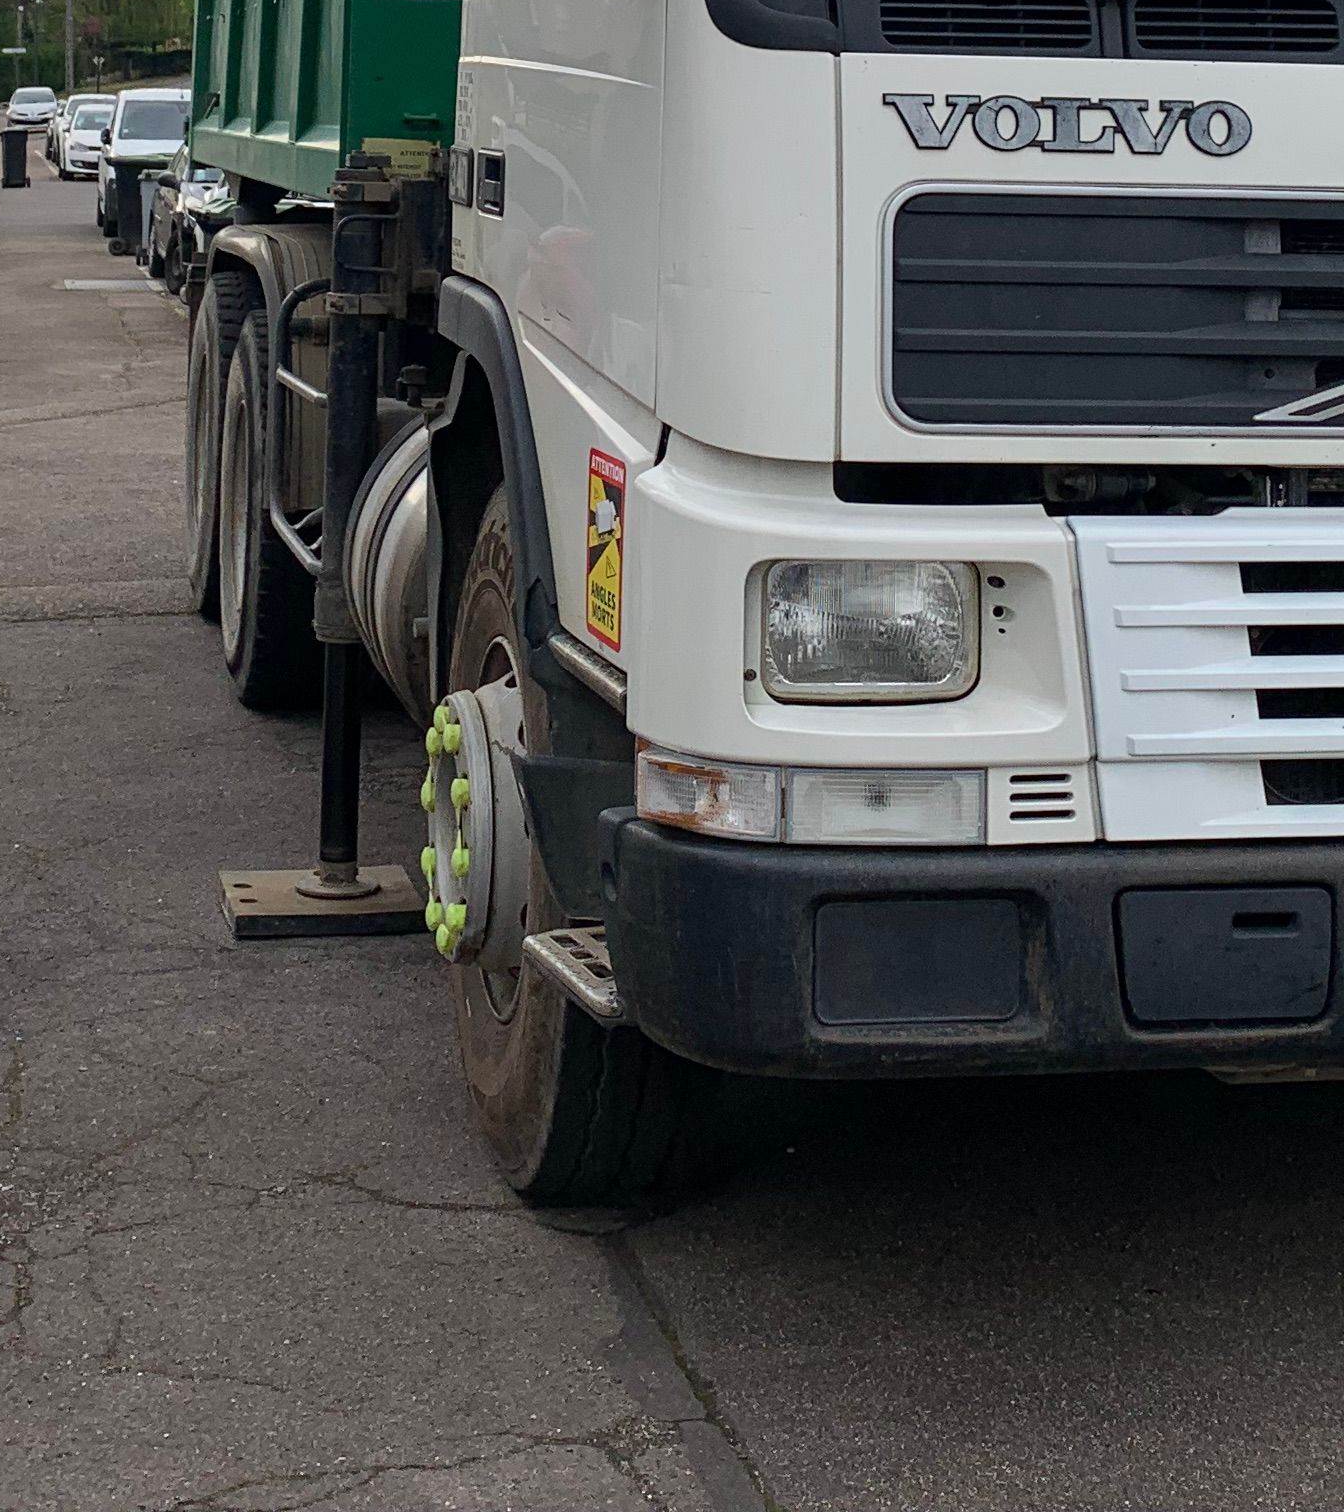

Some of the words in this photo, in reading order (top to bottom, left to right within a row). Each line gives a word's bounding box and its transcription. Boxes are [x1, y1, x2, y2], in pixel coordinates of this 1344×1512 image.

[882, 92, 1253, 157] VOLVO
[590, 454, 625, 485] ATTENTION
[591, 580, 616, 611] ANGLES
[591, 600, 615, 631] MORTS
